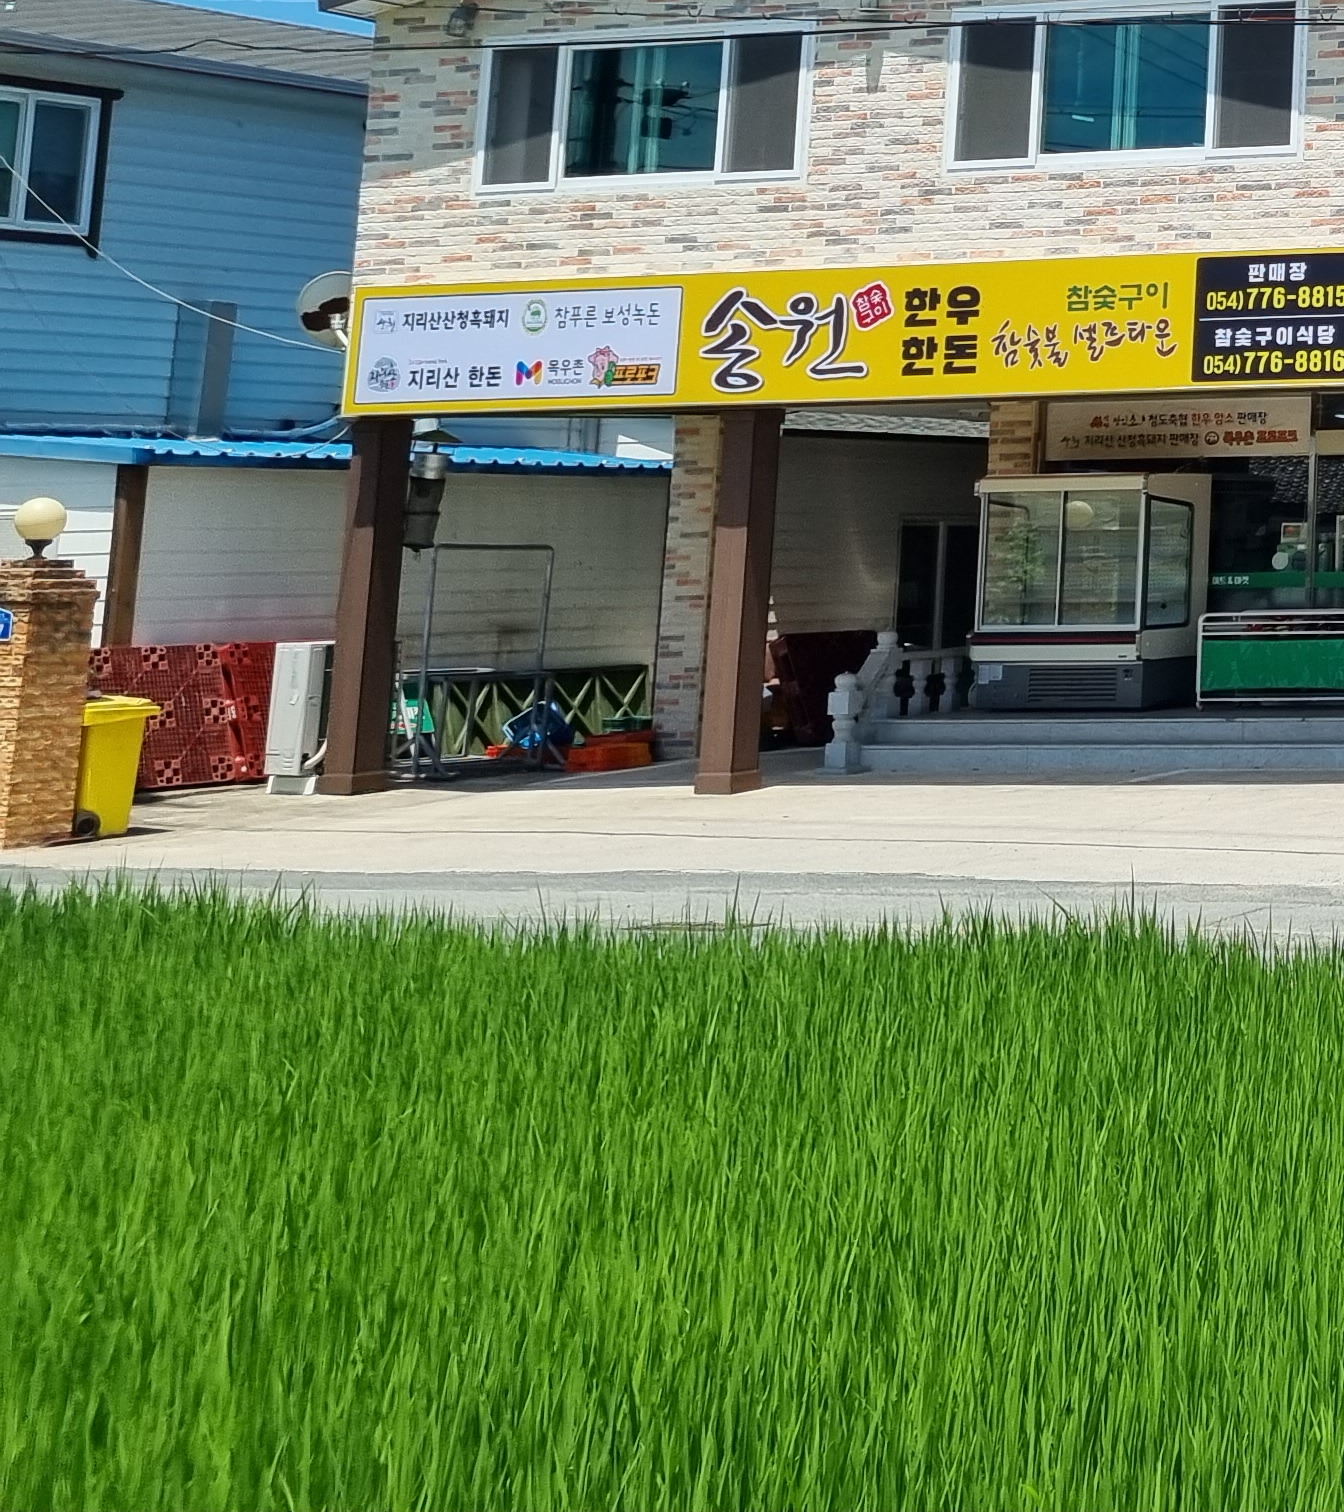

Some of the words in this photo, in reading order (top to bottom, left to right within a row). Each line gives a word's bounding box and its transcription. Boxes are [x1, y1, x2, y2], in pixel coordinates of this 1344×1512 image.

[1248, 262, 1307, 282] 판매장
[904, 286, 981, 327] 한우
[1066, 282, 1169, 312] 참숯구이
[402, 308, 510, 331] 지리산산청흑돼지
[555, 305, 598, 329] 참푸른
[602, 302, 661, 326] 보성녹돈
[700, 288, 867, 391] 송원
[991, 319, 1069, 369] 참숯불
[1215, 325, 1335, 347] 참숯구이식당
[547, 359, 584, 376] 목우촌
[901, 334, 978, 377] 한돈
[408, 366, 460, 390] 지리산
[468, 365, 502, 388] 한돈
